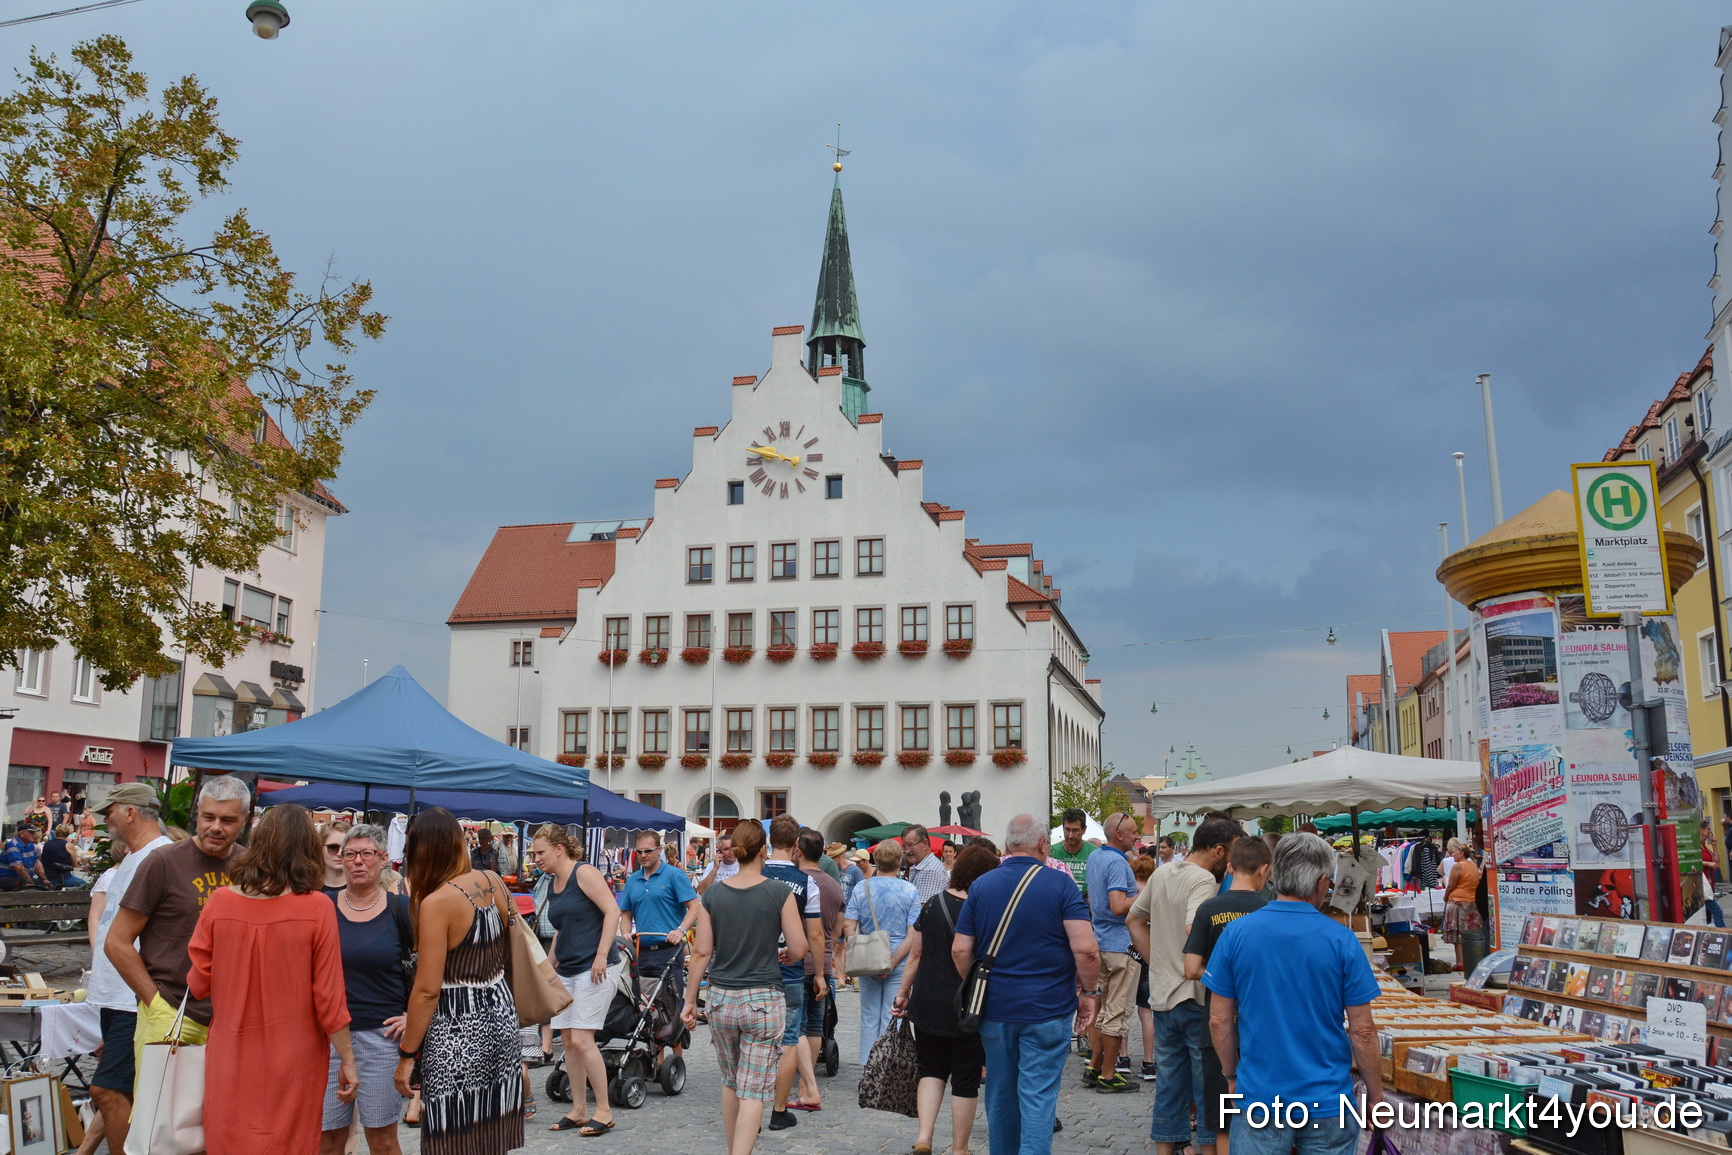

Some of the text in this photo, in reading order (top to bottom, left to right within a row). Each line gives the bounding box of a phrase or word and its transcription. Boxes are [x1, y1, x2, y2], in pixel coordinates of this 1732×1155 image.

[1595, 537, 1648, 547] Marktplatz
[1560, 643, 1630, 654] LEUNORA SALIHU
[79, 745, 114, 764] Achatz
[1571, 772, 1640, 783] LEUNORA SALIHU
[1516, 783, 1548, 802] August
[1511, 885, 1536, 895] Jahre
[1539, 885, 1573, 897] Pölling
[1515, 896, 1574, 905] Festwochenende
[1541, 906, 1559, 914] 2018
[1666, 1002, 1683, 1013] DVD
[1675, 1017, 1687, 1027] Euro
[1652, 1026, 1665, 1036] Stück
[1692, 1032, 1705, 1043] Euro
